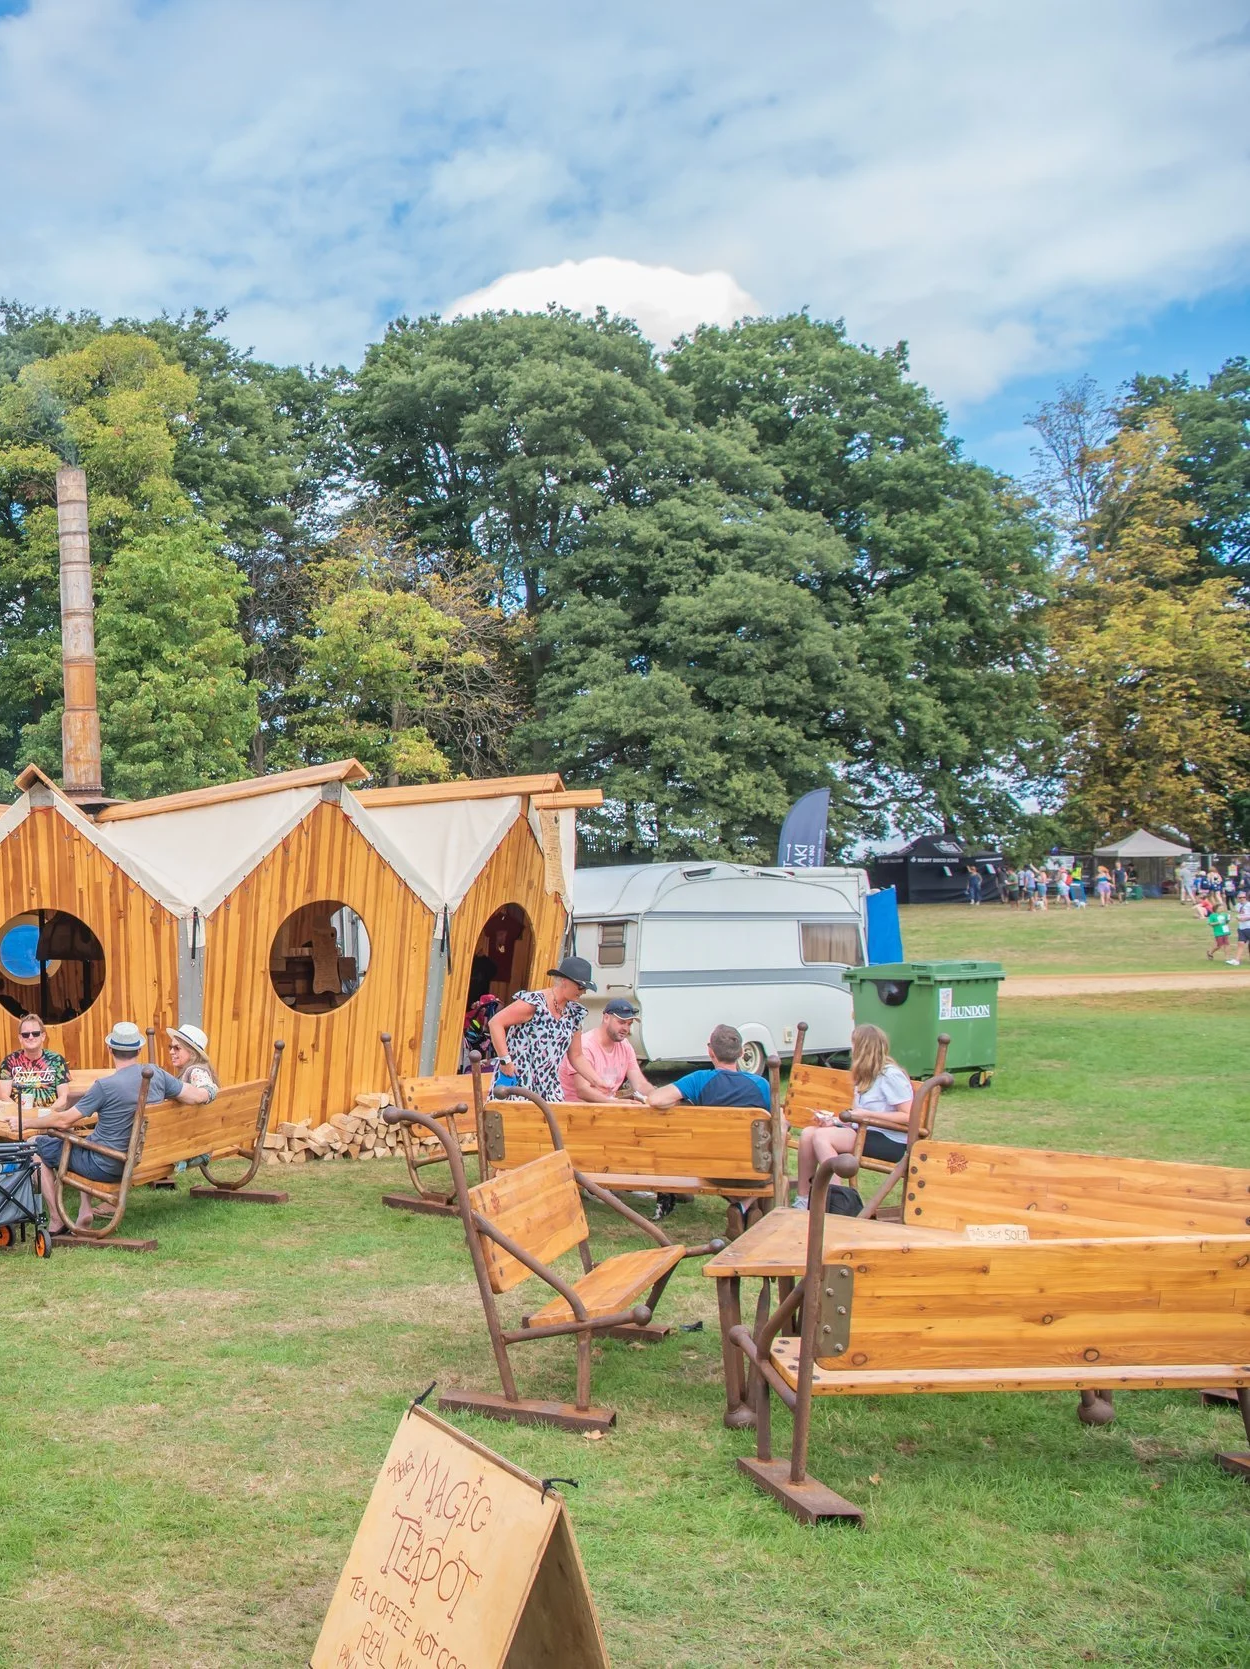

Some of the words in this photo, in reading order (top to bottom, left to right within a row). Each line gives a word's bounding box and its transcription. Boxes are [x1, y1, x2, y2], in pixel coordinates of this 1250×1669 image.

[794, 844, 808, 867] AKI
[951, 1004, 990, 1017] RUNDON
[386, 1451, 415, 1486] THE
[404, 1450, 492, 1549] MAGIC
[379, 1505, 483, 1623] TEAPOT
[350, 1576, 368, 1605] TEA
[369, 1590, 413, 1638] COFFEE
[412, 1625, 439, 1660] HOT
[356, 1621, 389, 1668] REAL
